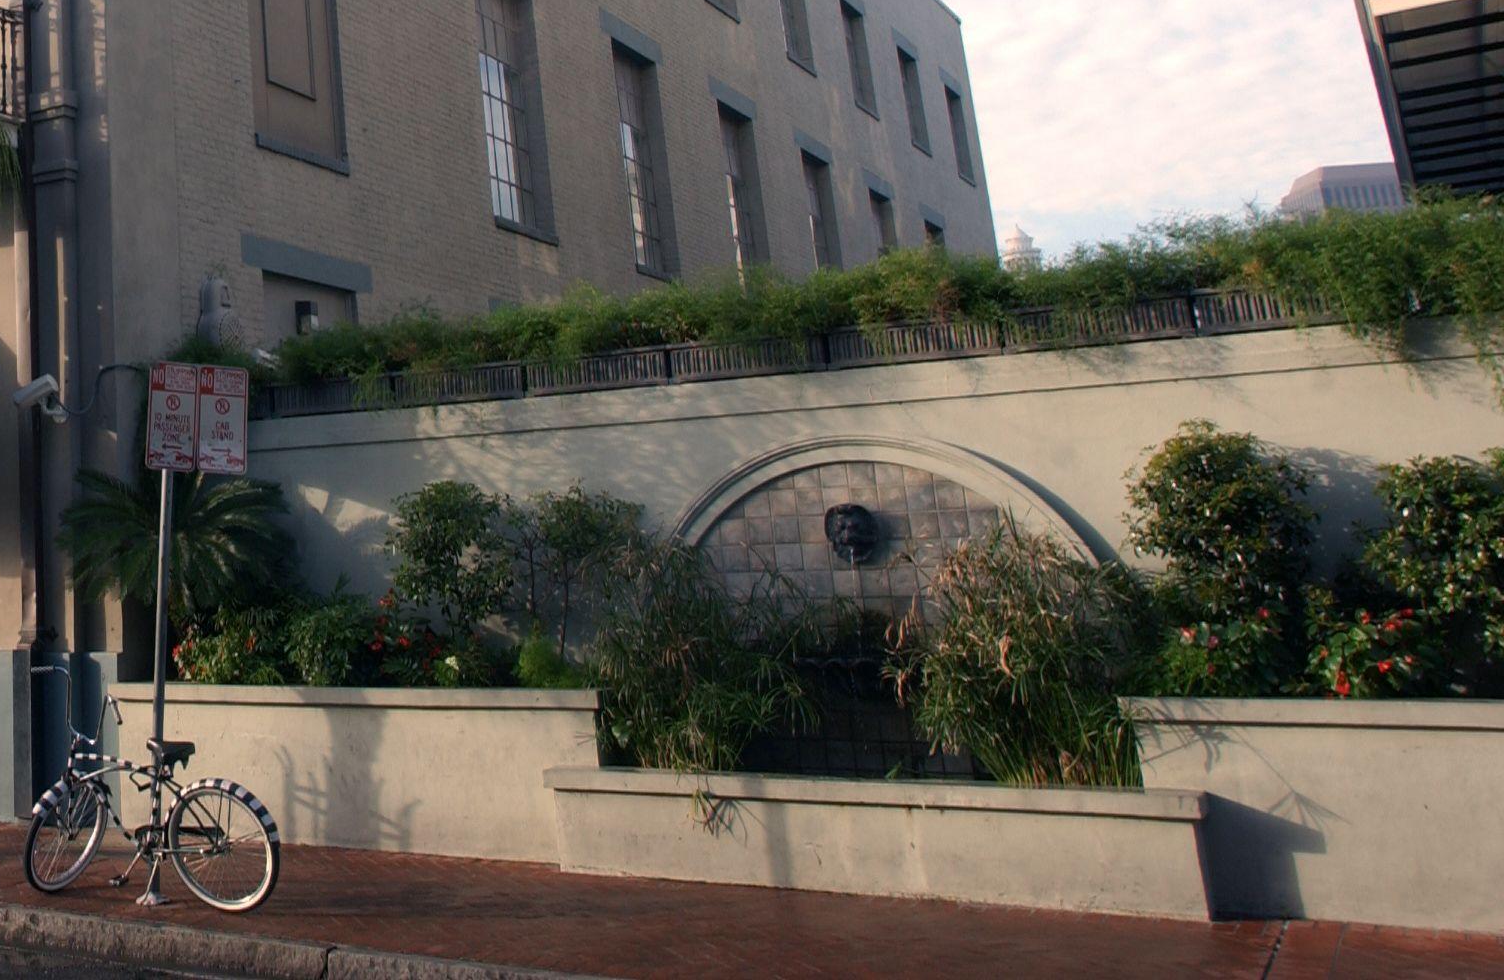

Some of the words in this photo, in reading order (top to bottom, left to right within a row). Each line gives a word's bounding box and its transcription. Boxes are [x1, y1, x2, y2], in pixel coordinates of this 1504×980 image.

[152, 369, 164, 385] NO
[201, 373, 213, 389] NO
[165, 414, 191, 423] MINUTE
[154, 421, 191, 432] PASSENGER
[215, 421, 230, 430] CAB
[162, 431, 181, 441] ZONE
[211, 430, 234, 440] STAND
